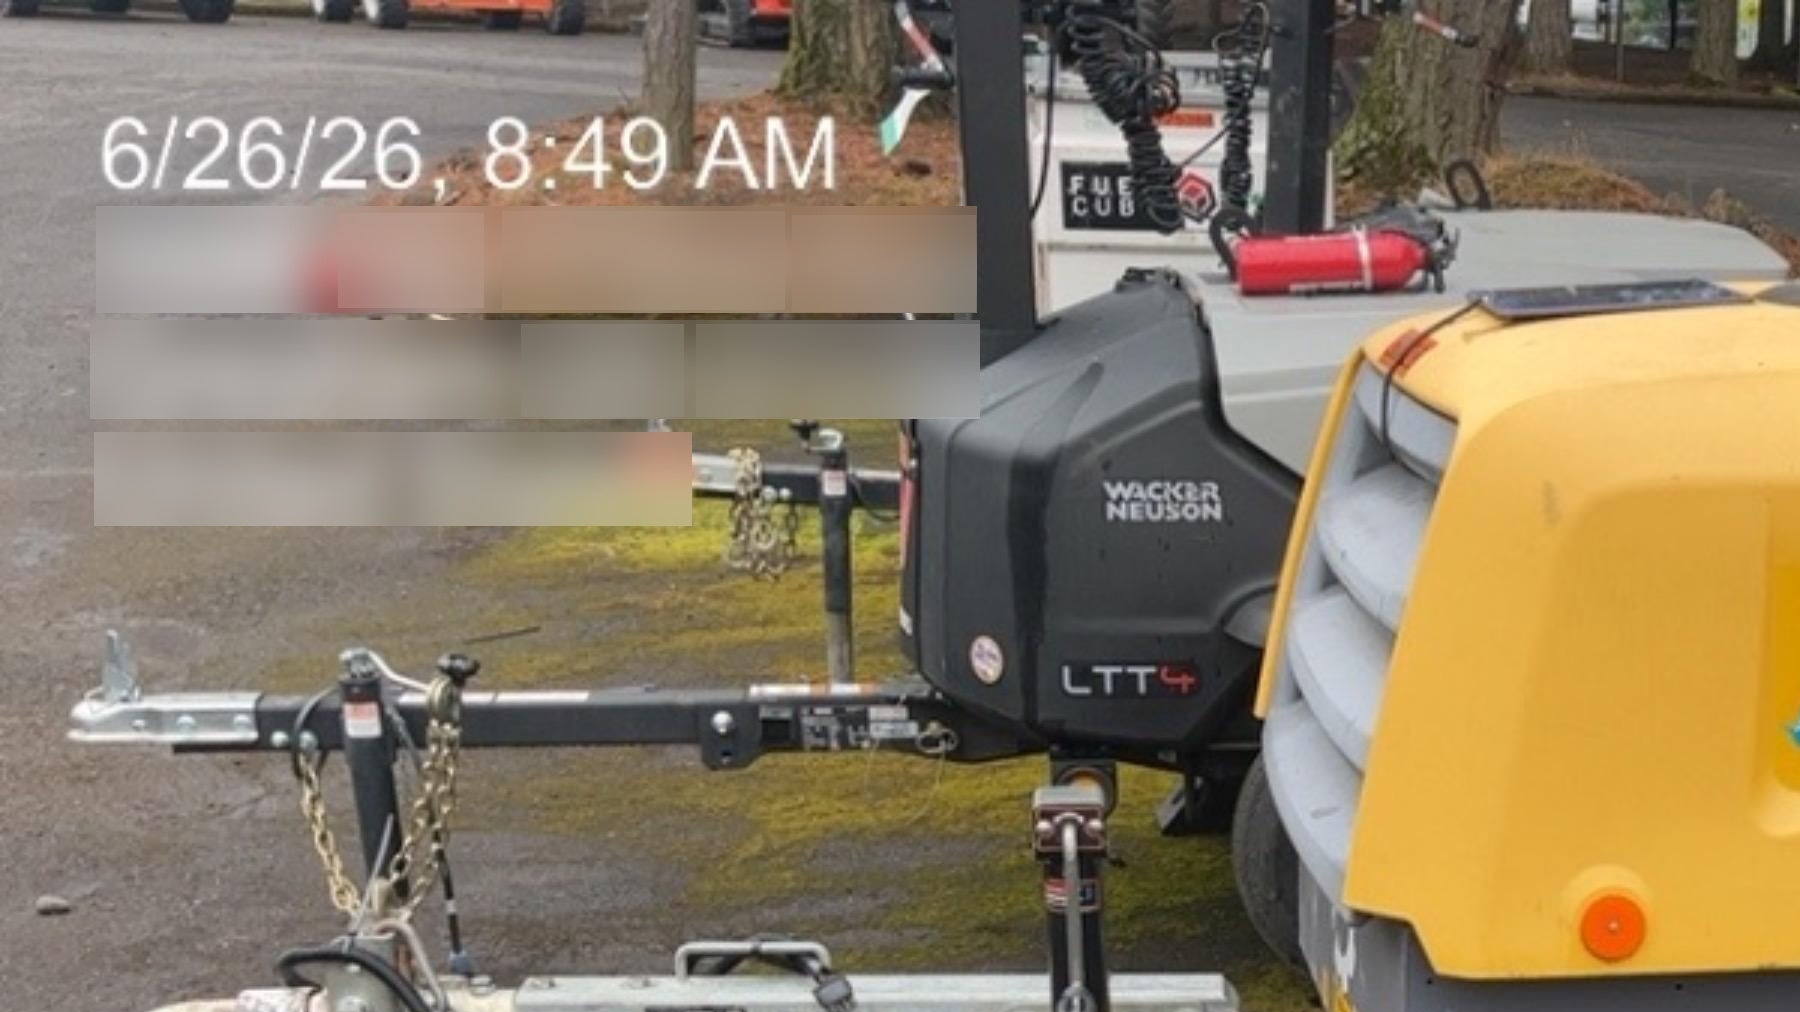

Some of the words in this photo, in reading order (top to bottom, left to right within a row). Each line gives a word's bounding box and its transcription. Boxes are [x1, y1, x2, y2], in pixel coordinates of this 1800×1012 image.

[1102, 480, 1221, 501] WACKER
[1105, 500, 1223, 522] NEUSON
[1061, 664, 1197, 695] LTT4
